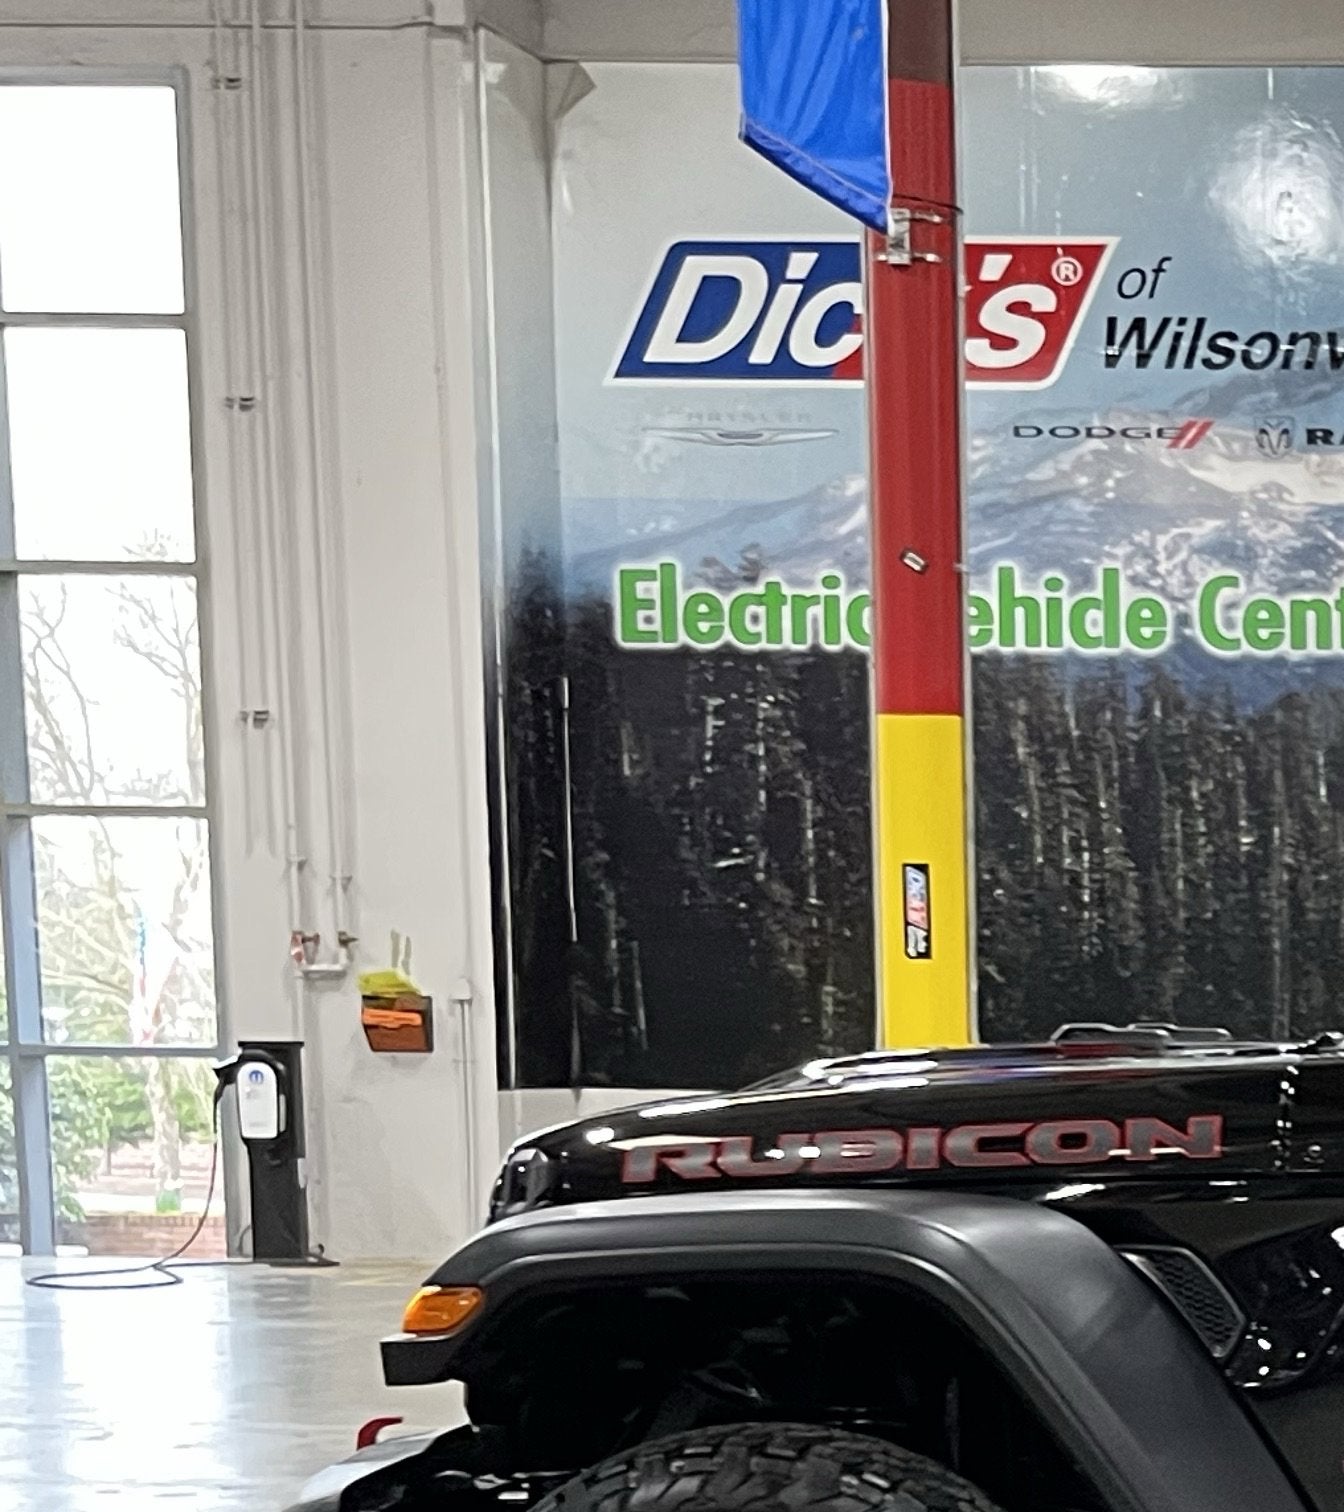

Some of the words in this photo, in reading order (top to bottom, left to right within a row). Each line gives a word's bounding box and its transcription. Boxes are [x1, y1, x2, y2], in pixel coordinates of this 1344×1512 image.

[1117, 256, 1173, 300] of
[1012, 424, 1182, 440] DODGE
[968, 565, 1168, 650] ehicle
[621, 1114, 1224, 1184] RUBICON
